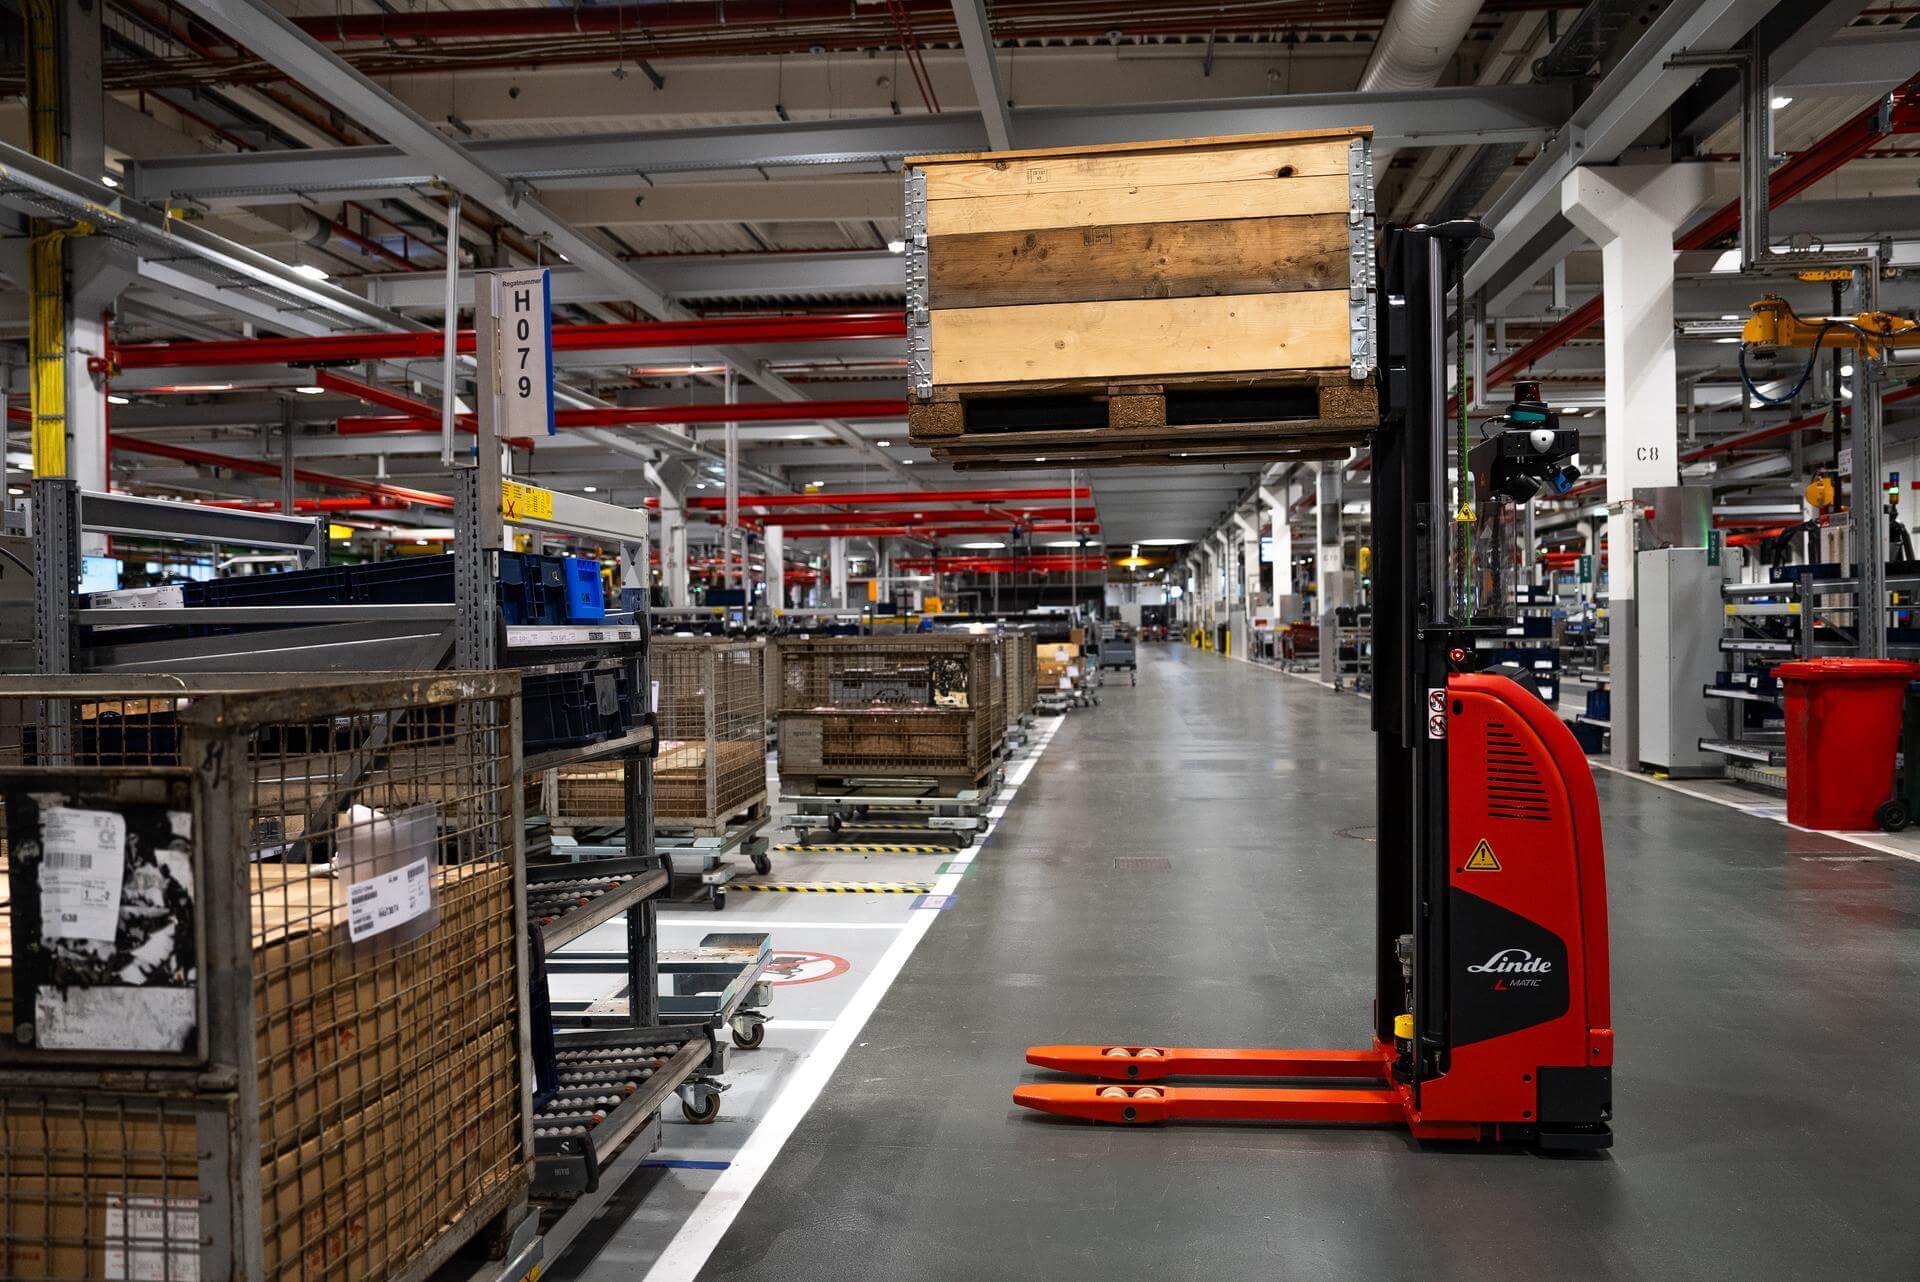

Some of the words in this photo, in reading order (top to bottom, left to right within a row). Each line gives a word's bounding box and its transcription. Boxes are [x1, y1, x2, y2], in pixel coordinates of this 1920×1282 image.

[502, 279, 542, 287] Regalnummer
[514, 289, 531, 398] H079
[1636, 447, 1658, 461] C8
[1467, 949, 1552, 973] Linde
[1509, 979, 1542, 987] MATIC
